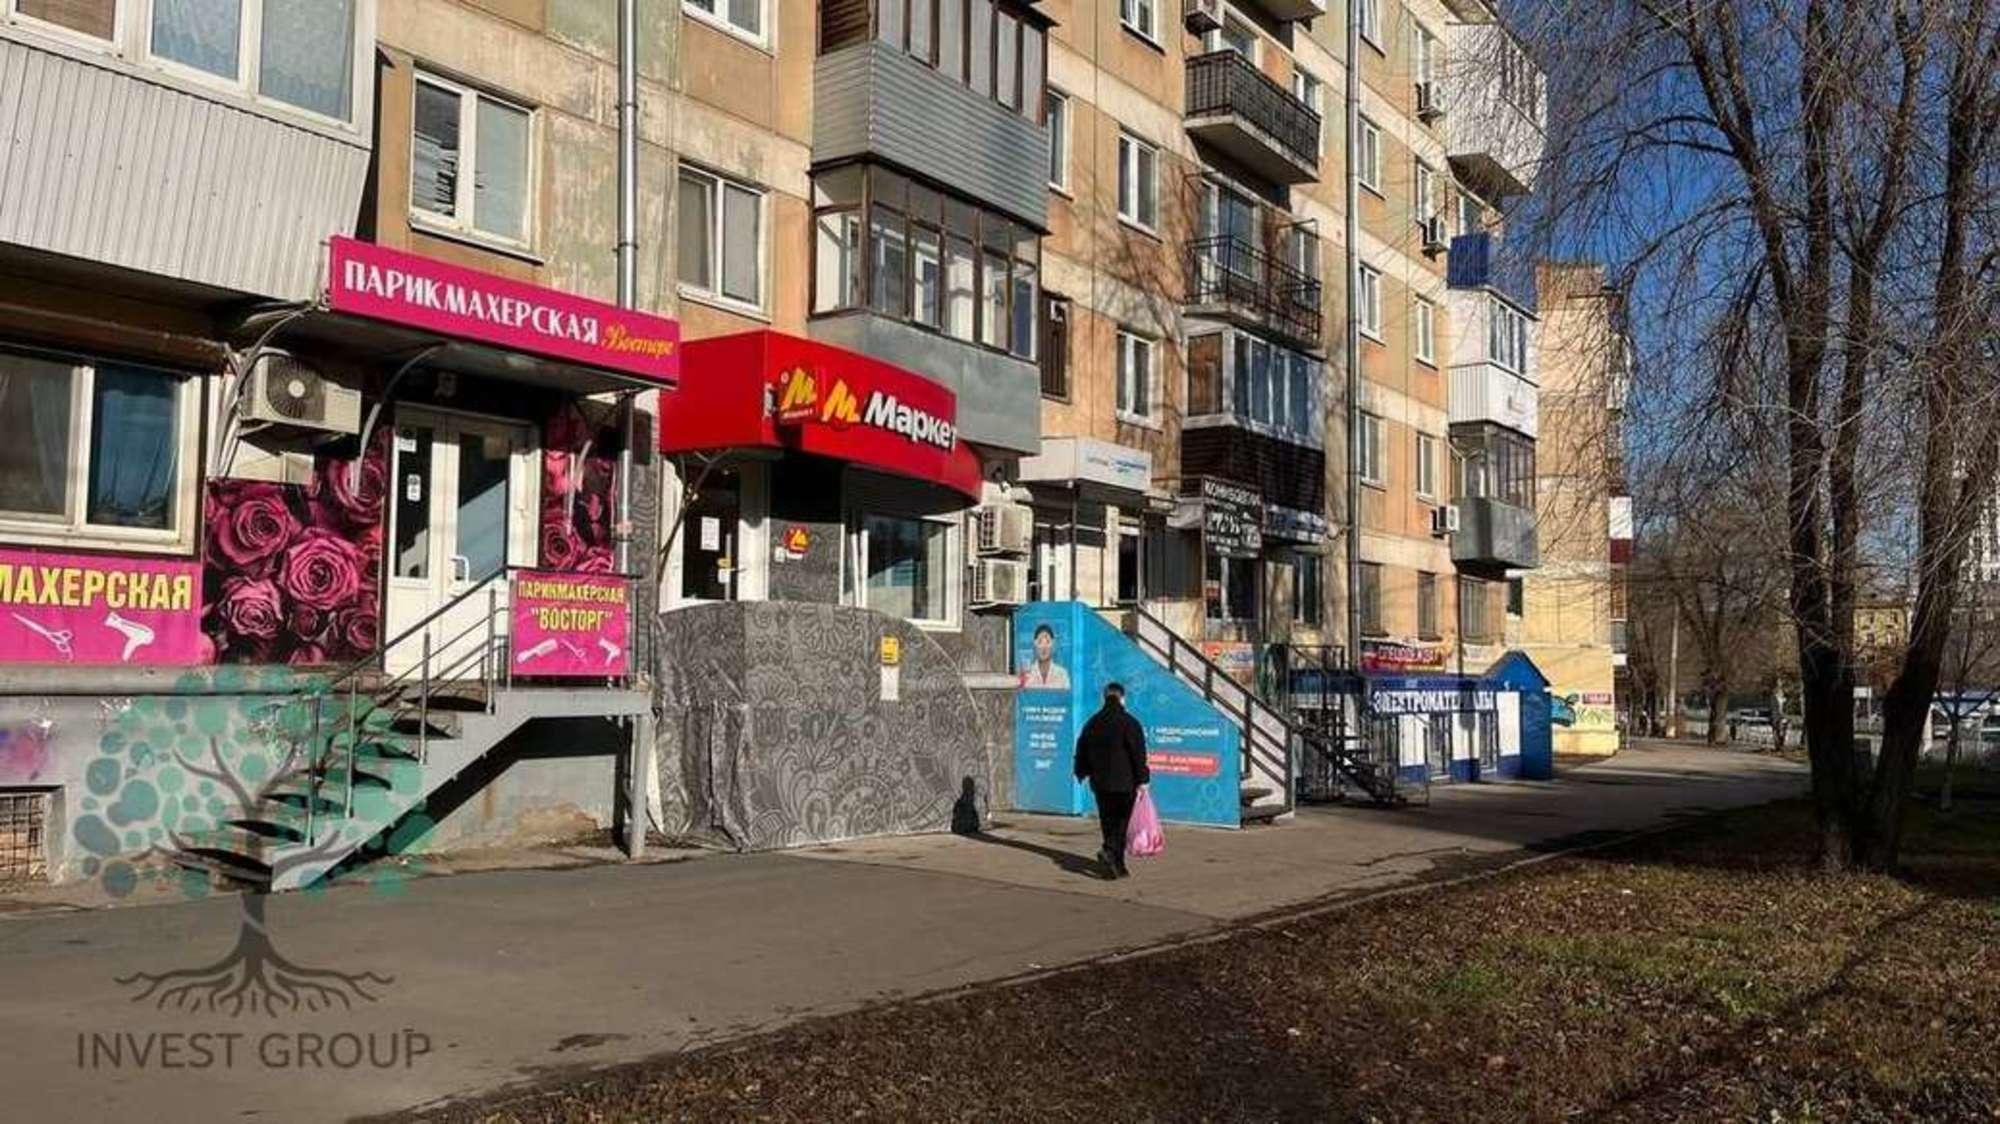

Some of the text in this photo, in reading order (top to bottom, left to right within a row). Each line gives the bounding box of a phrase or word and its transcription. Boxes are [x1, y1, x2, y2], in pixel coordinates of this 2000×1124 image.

[344, 259, 599, 345] ПАРИКМАХЕРСКАЯ
[518, 580, 624, 604] ПАРИКМАХЕРСКАЯ
[531, 606, 613, 631] "ВОСТОРГ"
